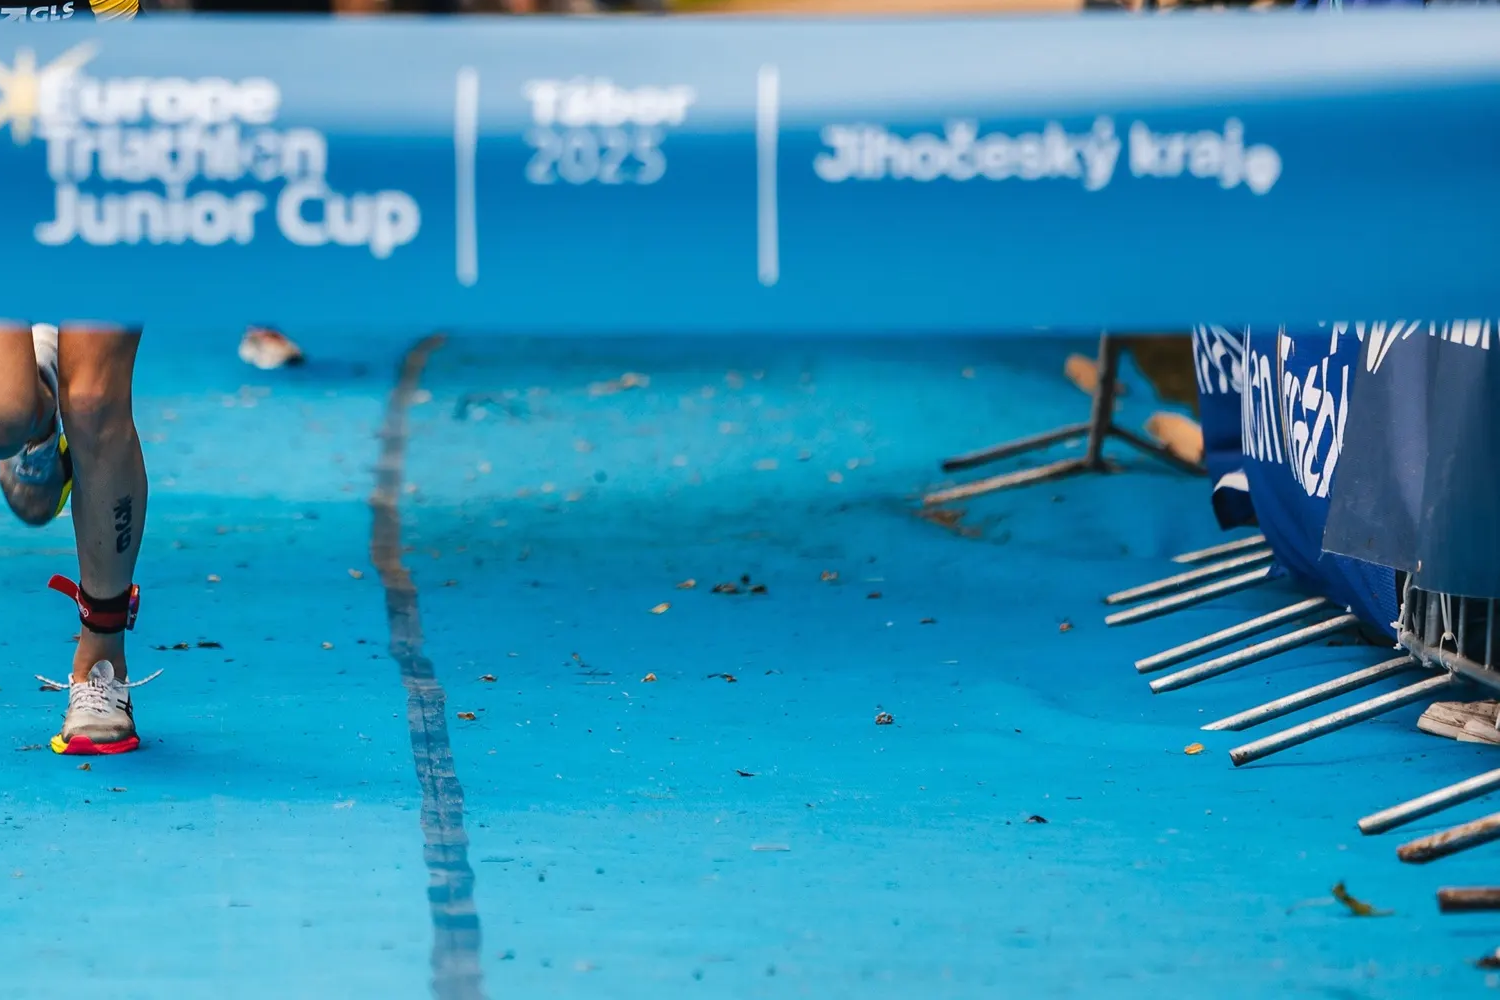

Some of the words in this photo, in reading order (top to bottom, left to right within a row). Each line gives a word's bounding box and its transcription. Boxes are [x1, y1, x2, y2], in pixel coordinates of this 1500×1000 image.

[29, 1, 75, 22] GLS
[37, 66, 282, 132] Europe
[521, 76, 696, 127] Tábor
[37, 127, 329, 184] Triathlon
[812, 117, 1121, 192] Jihočeský
[1126, 118, 1245, 190] kraj
[33, 182, 268, 247] Junior
[276, 183, 422, 260] Cup
